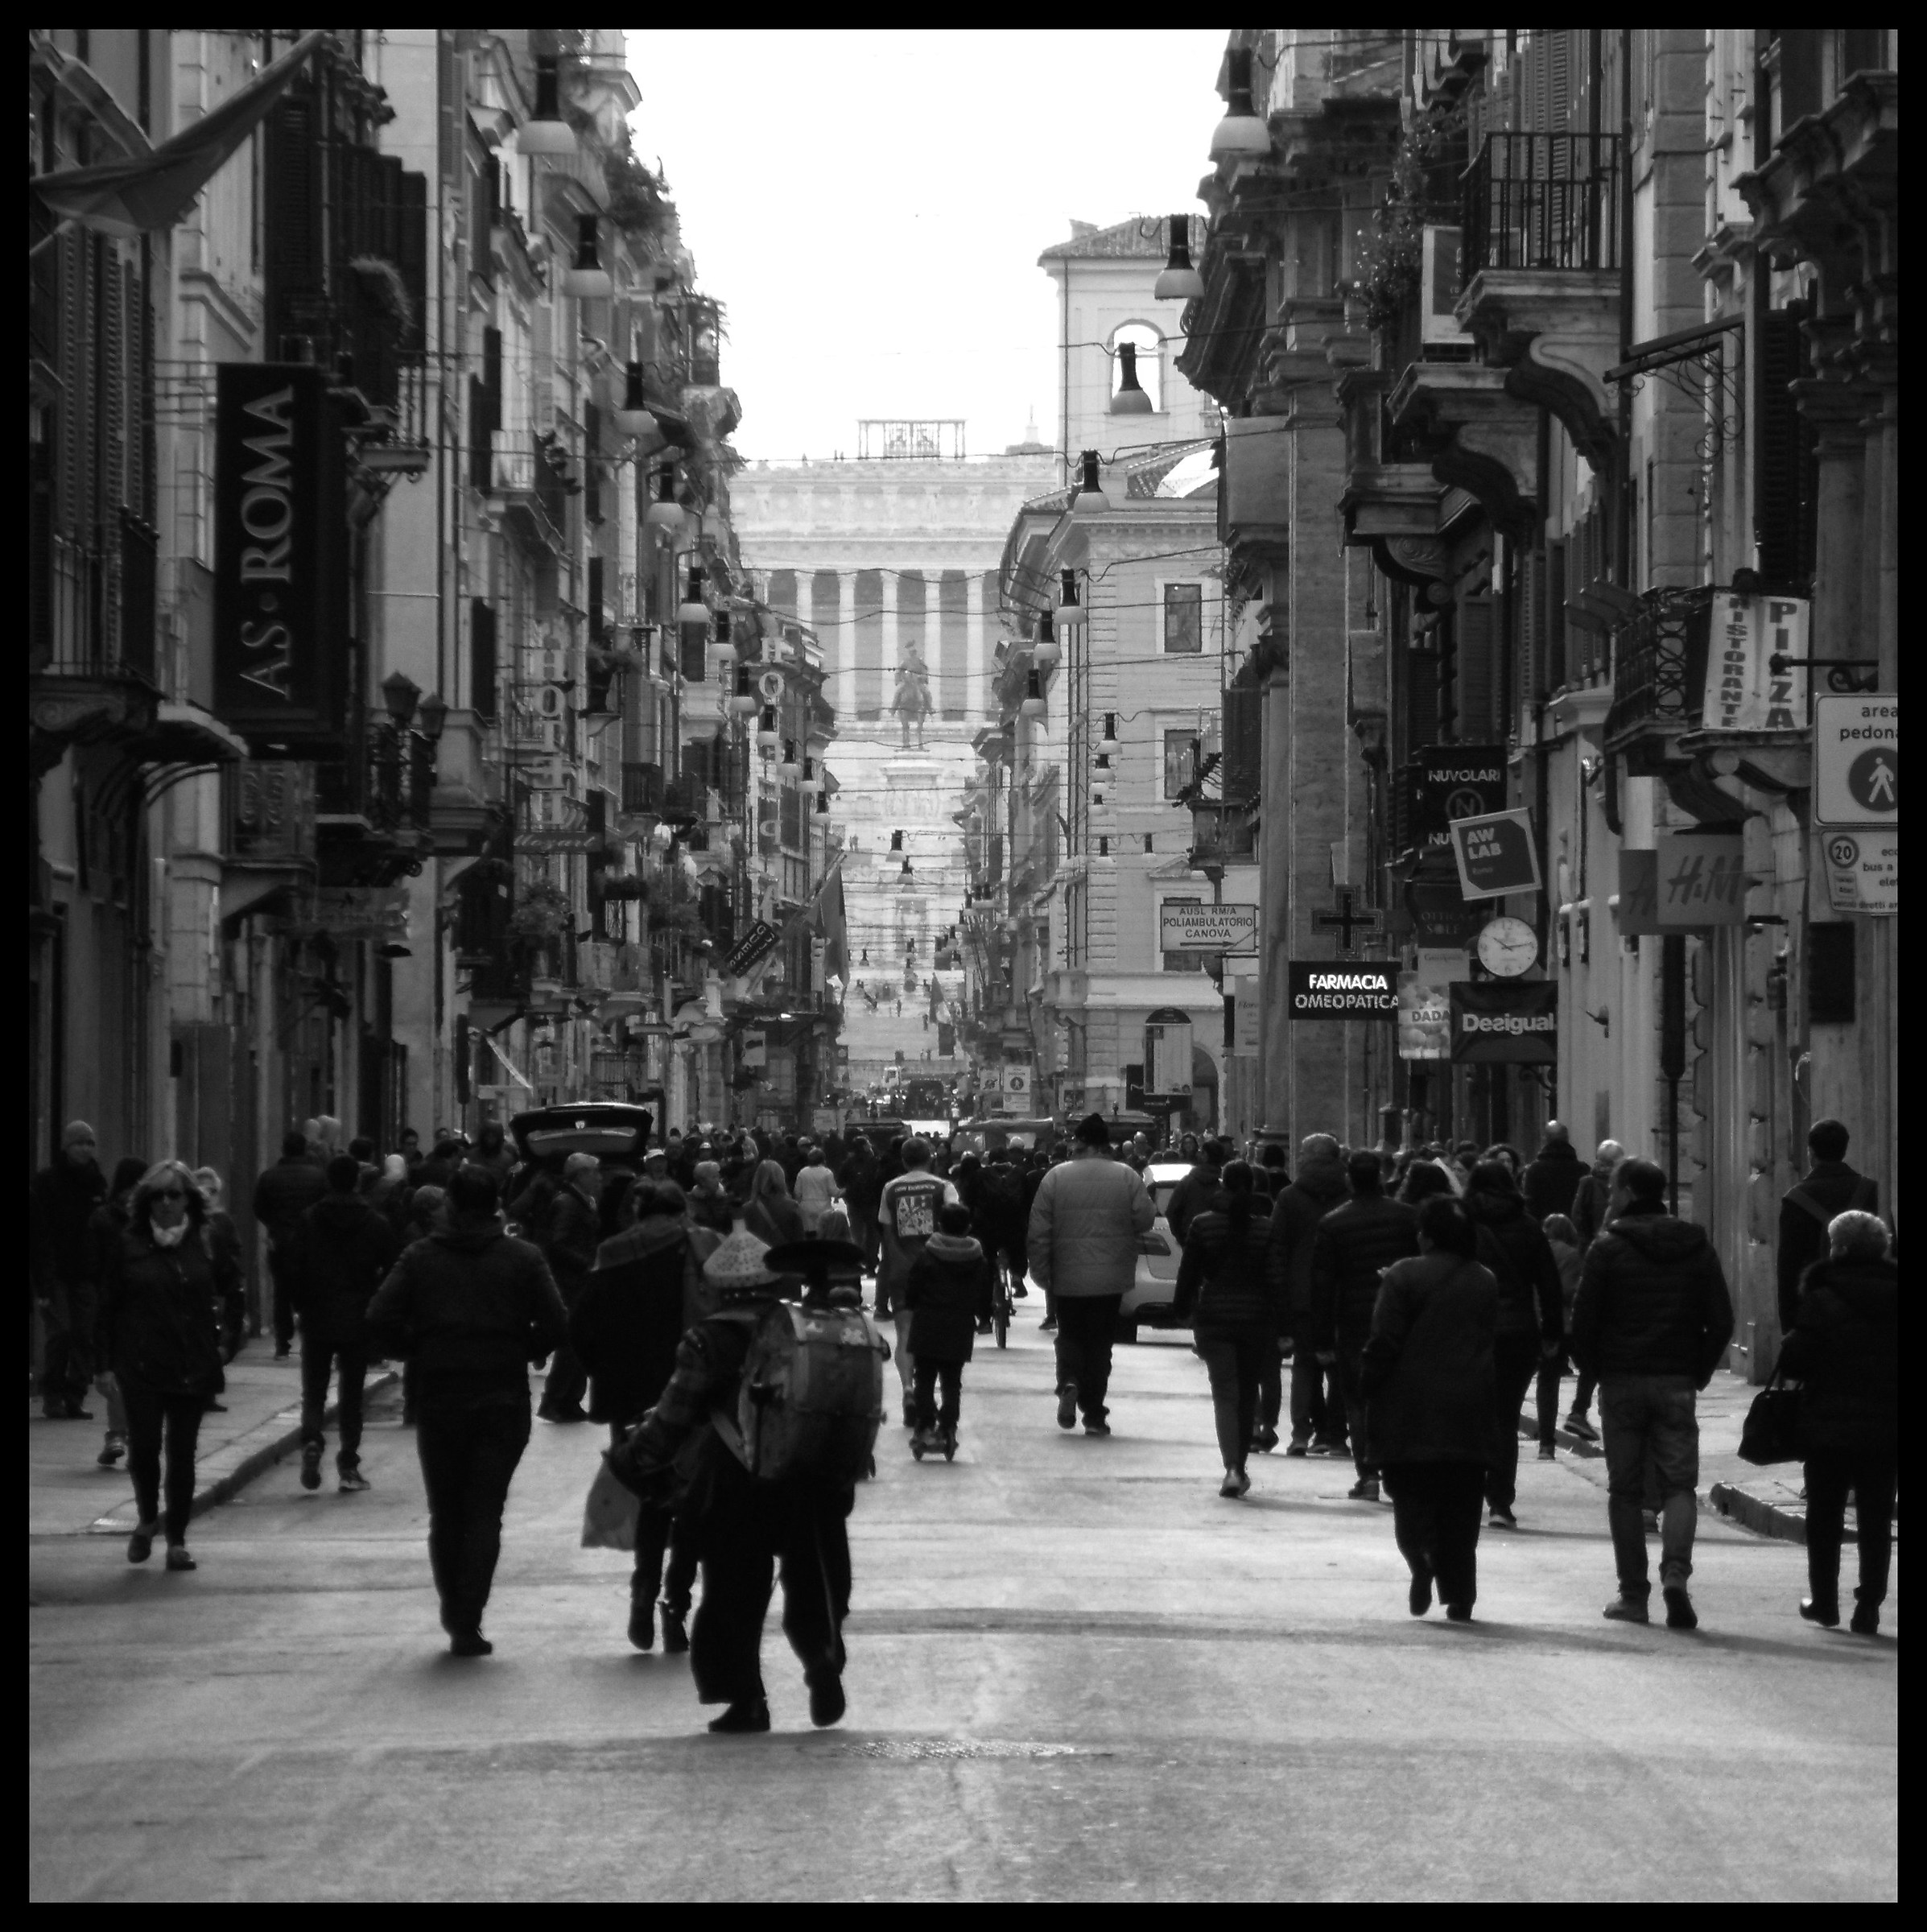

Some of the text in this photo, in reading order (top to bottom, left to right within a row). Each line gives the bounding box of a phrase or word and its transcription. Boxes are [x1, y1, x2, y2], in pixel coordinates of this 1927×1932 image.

[241, 385, 295, 585] ROMA
[1861, 706, 1898, 718] area
[1840, 725, 1898, 741] pedon
[1428, 769, 1501, 782] NUVOLARI
[1467, 828, 1495, 845] AW
[1467, 843, 1502, 861] LAB
[1834, 845, 1852, 860] 20
[1863, 862, 1893, 872] bus a
[1667, 855, 1743, 906] H&M
[1179, 907, 1207, 916] AUSL
[1163, 917, 1253, 927] POLIAMBULATORIO
[1185, 928, 1232, 939] CANOVA
[1309, 973, 1388, 990] FARMACIA
[1294, 993, 1399, 1009] OMEOPATICA
[1462, 1012, 1555, 1035] Desigual
